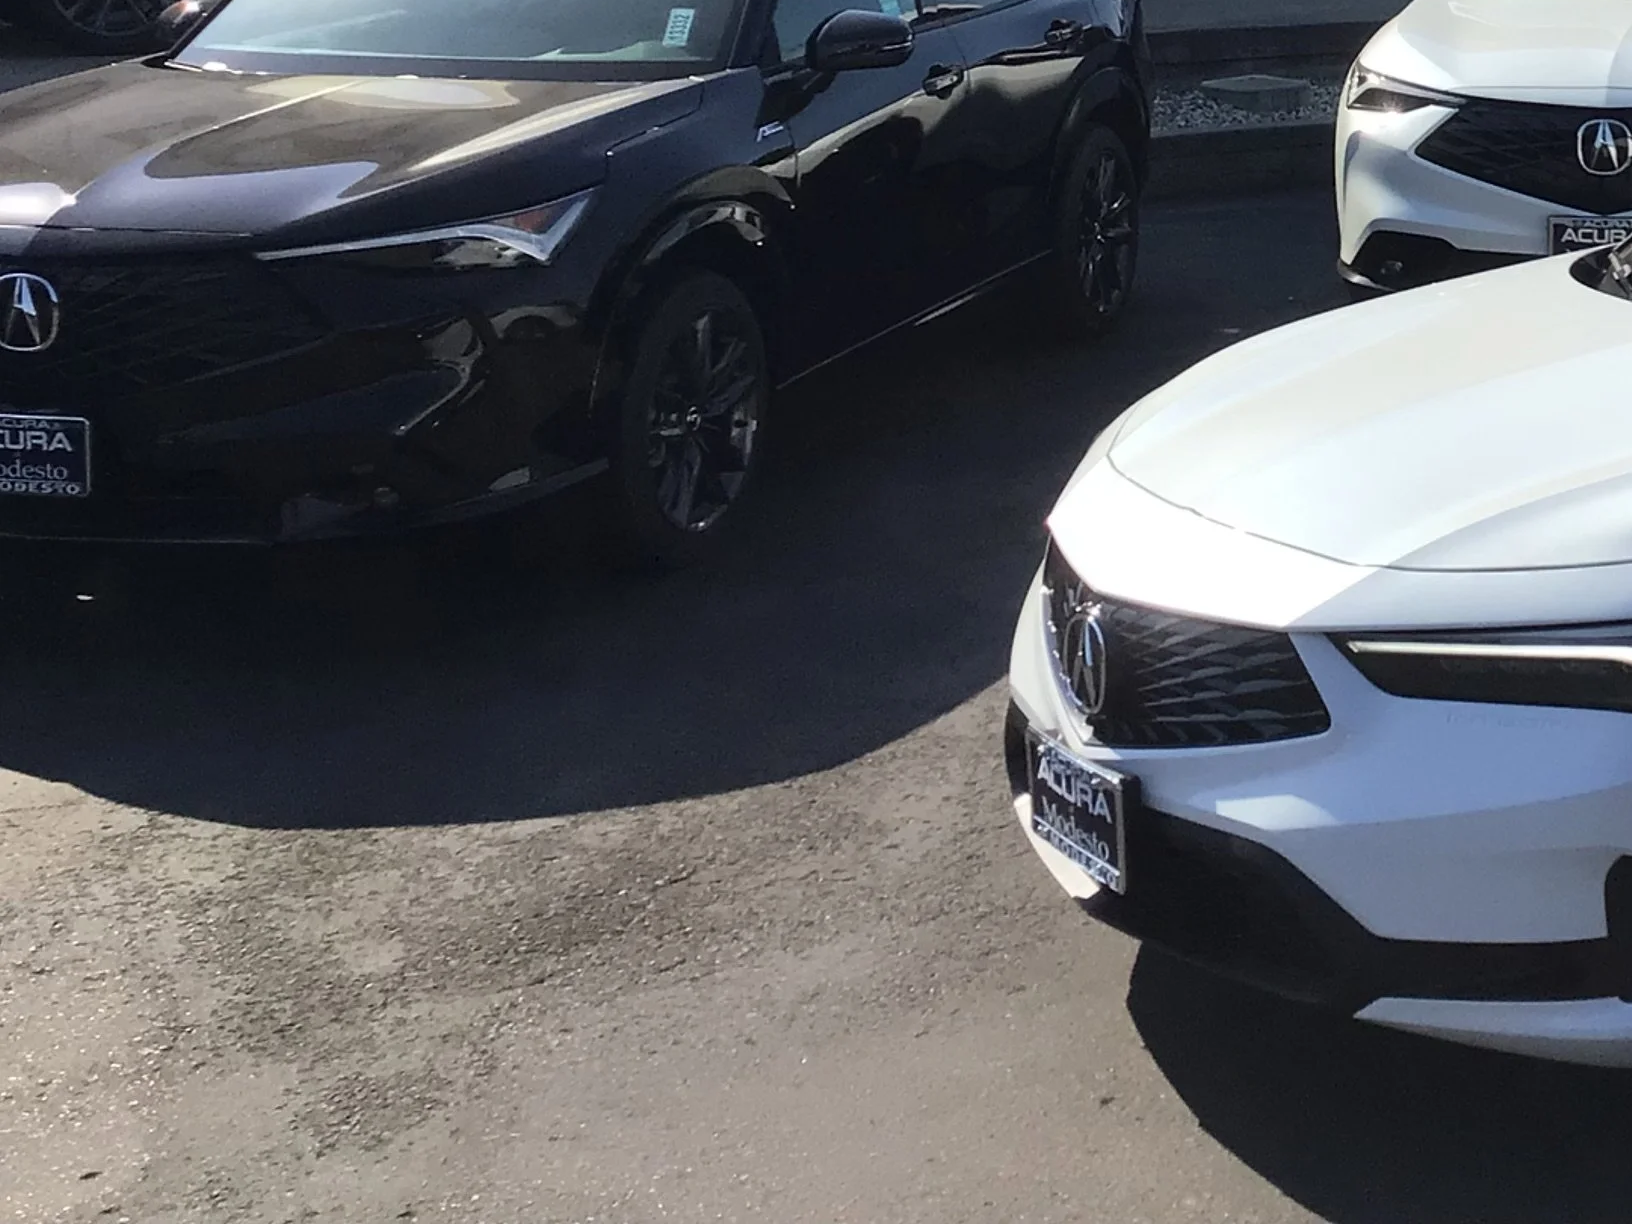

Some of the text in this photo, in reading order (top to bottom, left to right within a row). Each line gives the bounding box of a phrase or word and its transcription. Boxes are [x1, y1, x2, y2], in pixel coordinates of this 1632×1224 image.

[1561, 228, 1628, 244] ACUR
[0, 429, 73, 451] URA
[0, 458, 68, 480] odesto
[0, 481, 81, 494] ODESTO
[1037, 755, 1113, 824] ACURA
[1041, 795, 1110, 862] Modesto
